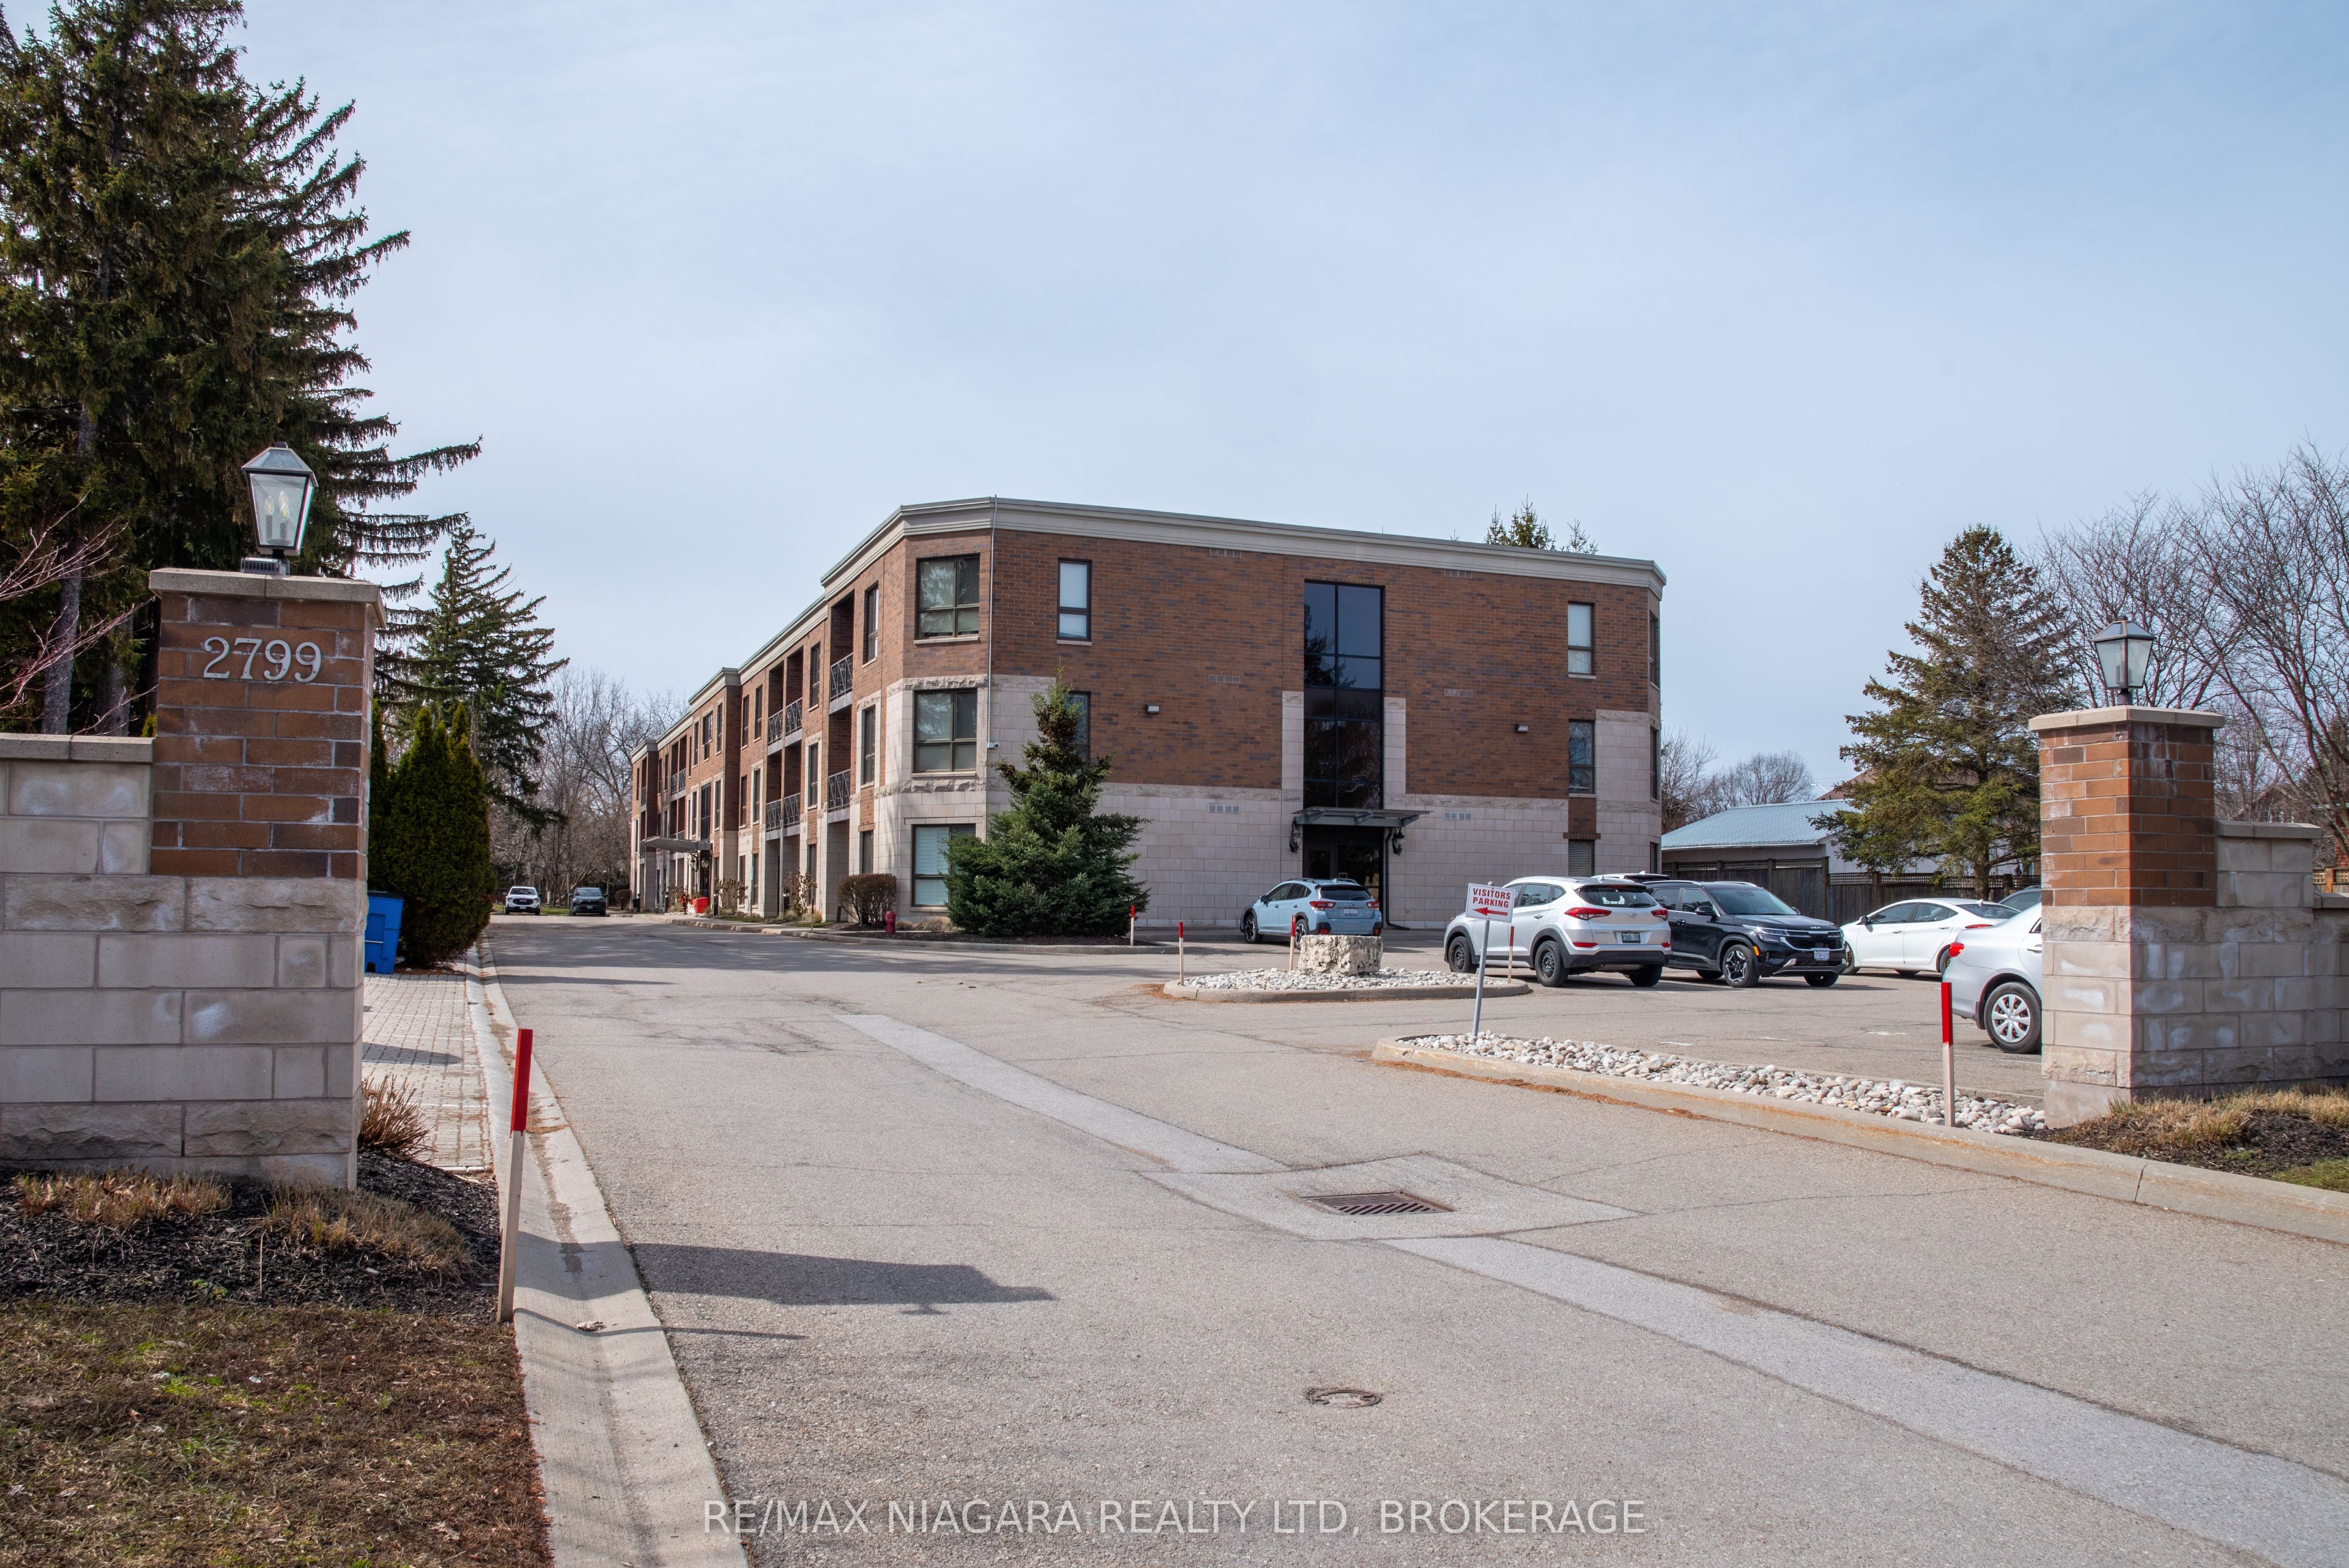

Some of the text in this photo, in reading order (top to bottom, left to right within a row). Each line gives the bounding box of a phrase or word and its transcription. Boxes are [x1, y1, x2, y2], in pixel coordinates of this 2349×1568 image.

[203, 636, 322, 683] 2799
[1473, 888, 1510, 900] VISITORS
[1472, 897, 1508, 908] PARKING
